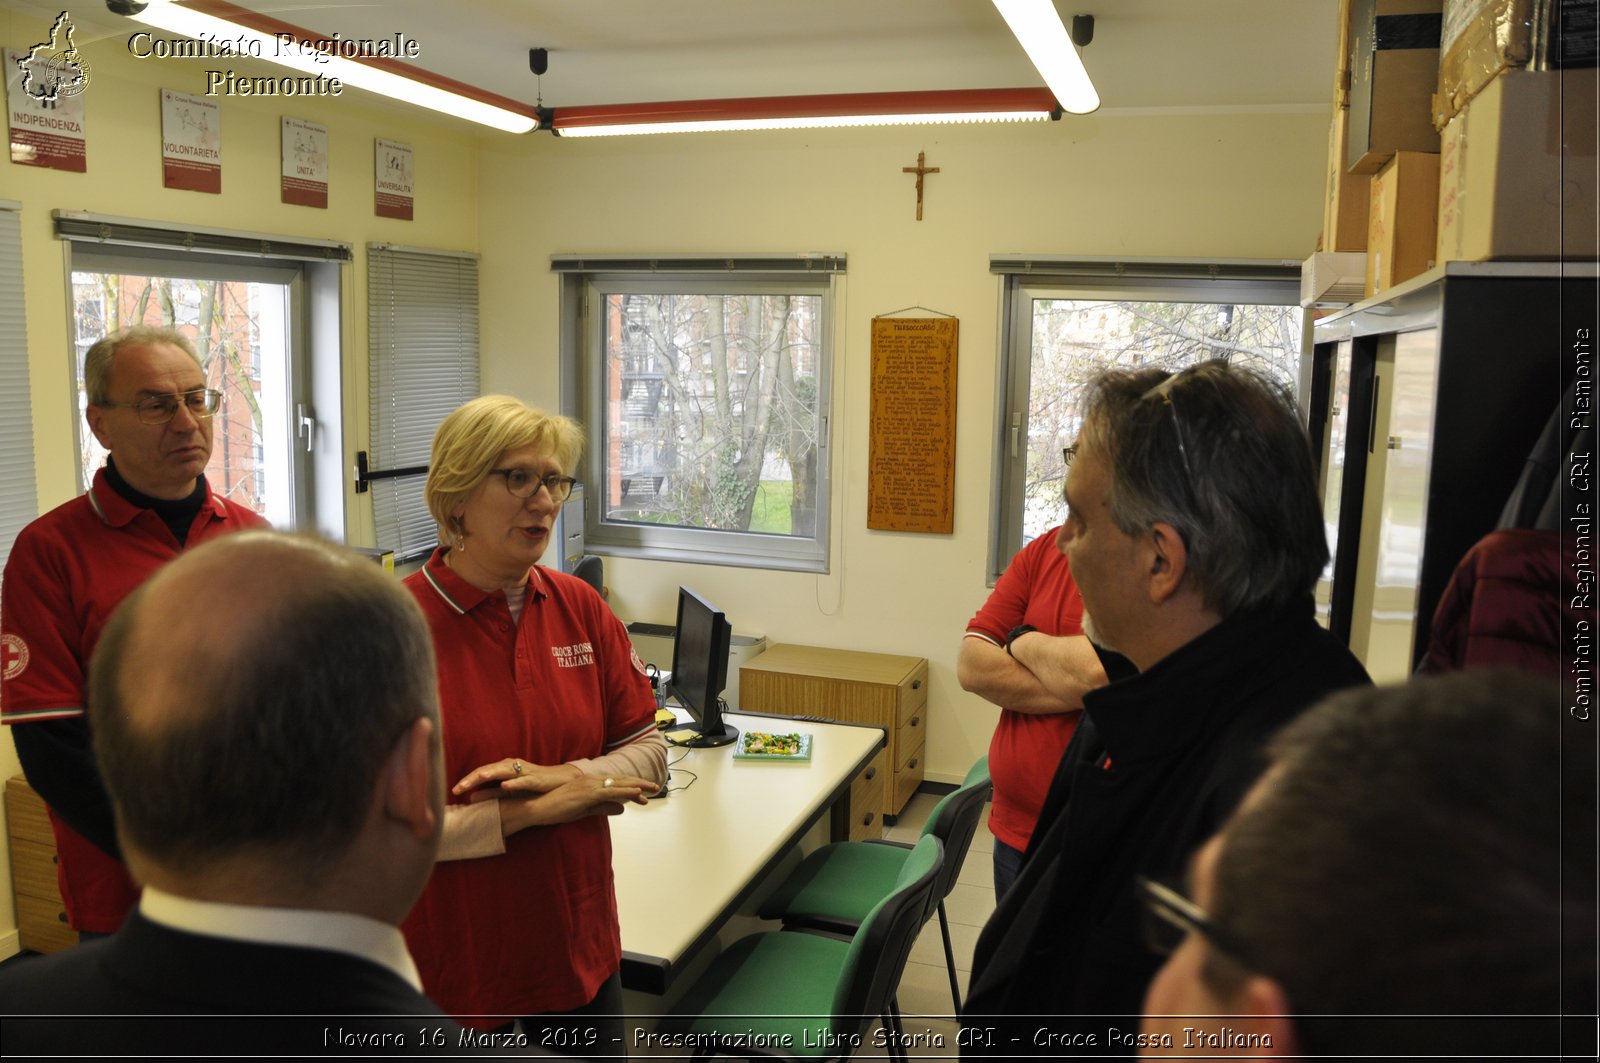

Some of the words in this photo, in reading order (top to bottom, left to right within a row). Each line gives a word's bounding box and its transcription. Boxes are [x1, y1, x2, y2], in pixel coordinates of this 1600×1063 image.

[14, 111, 82, 133] INDIPENDENZA
[551, 646, 573, 657] CROCE
[556, 653, 594, 668] ITALIANA
